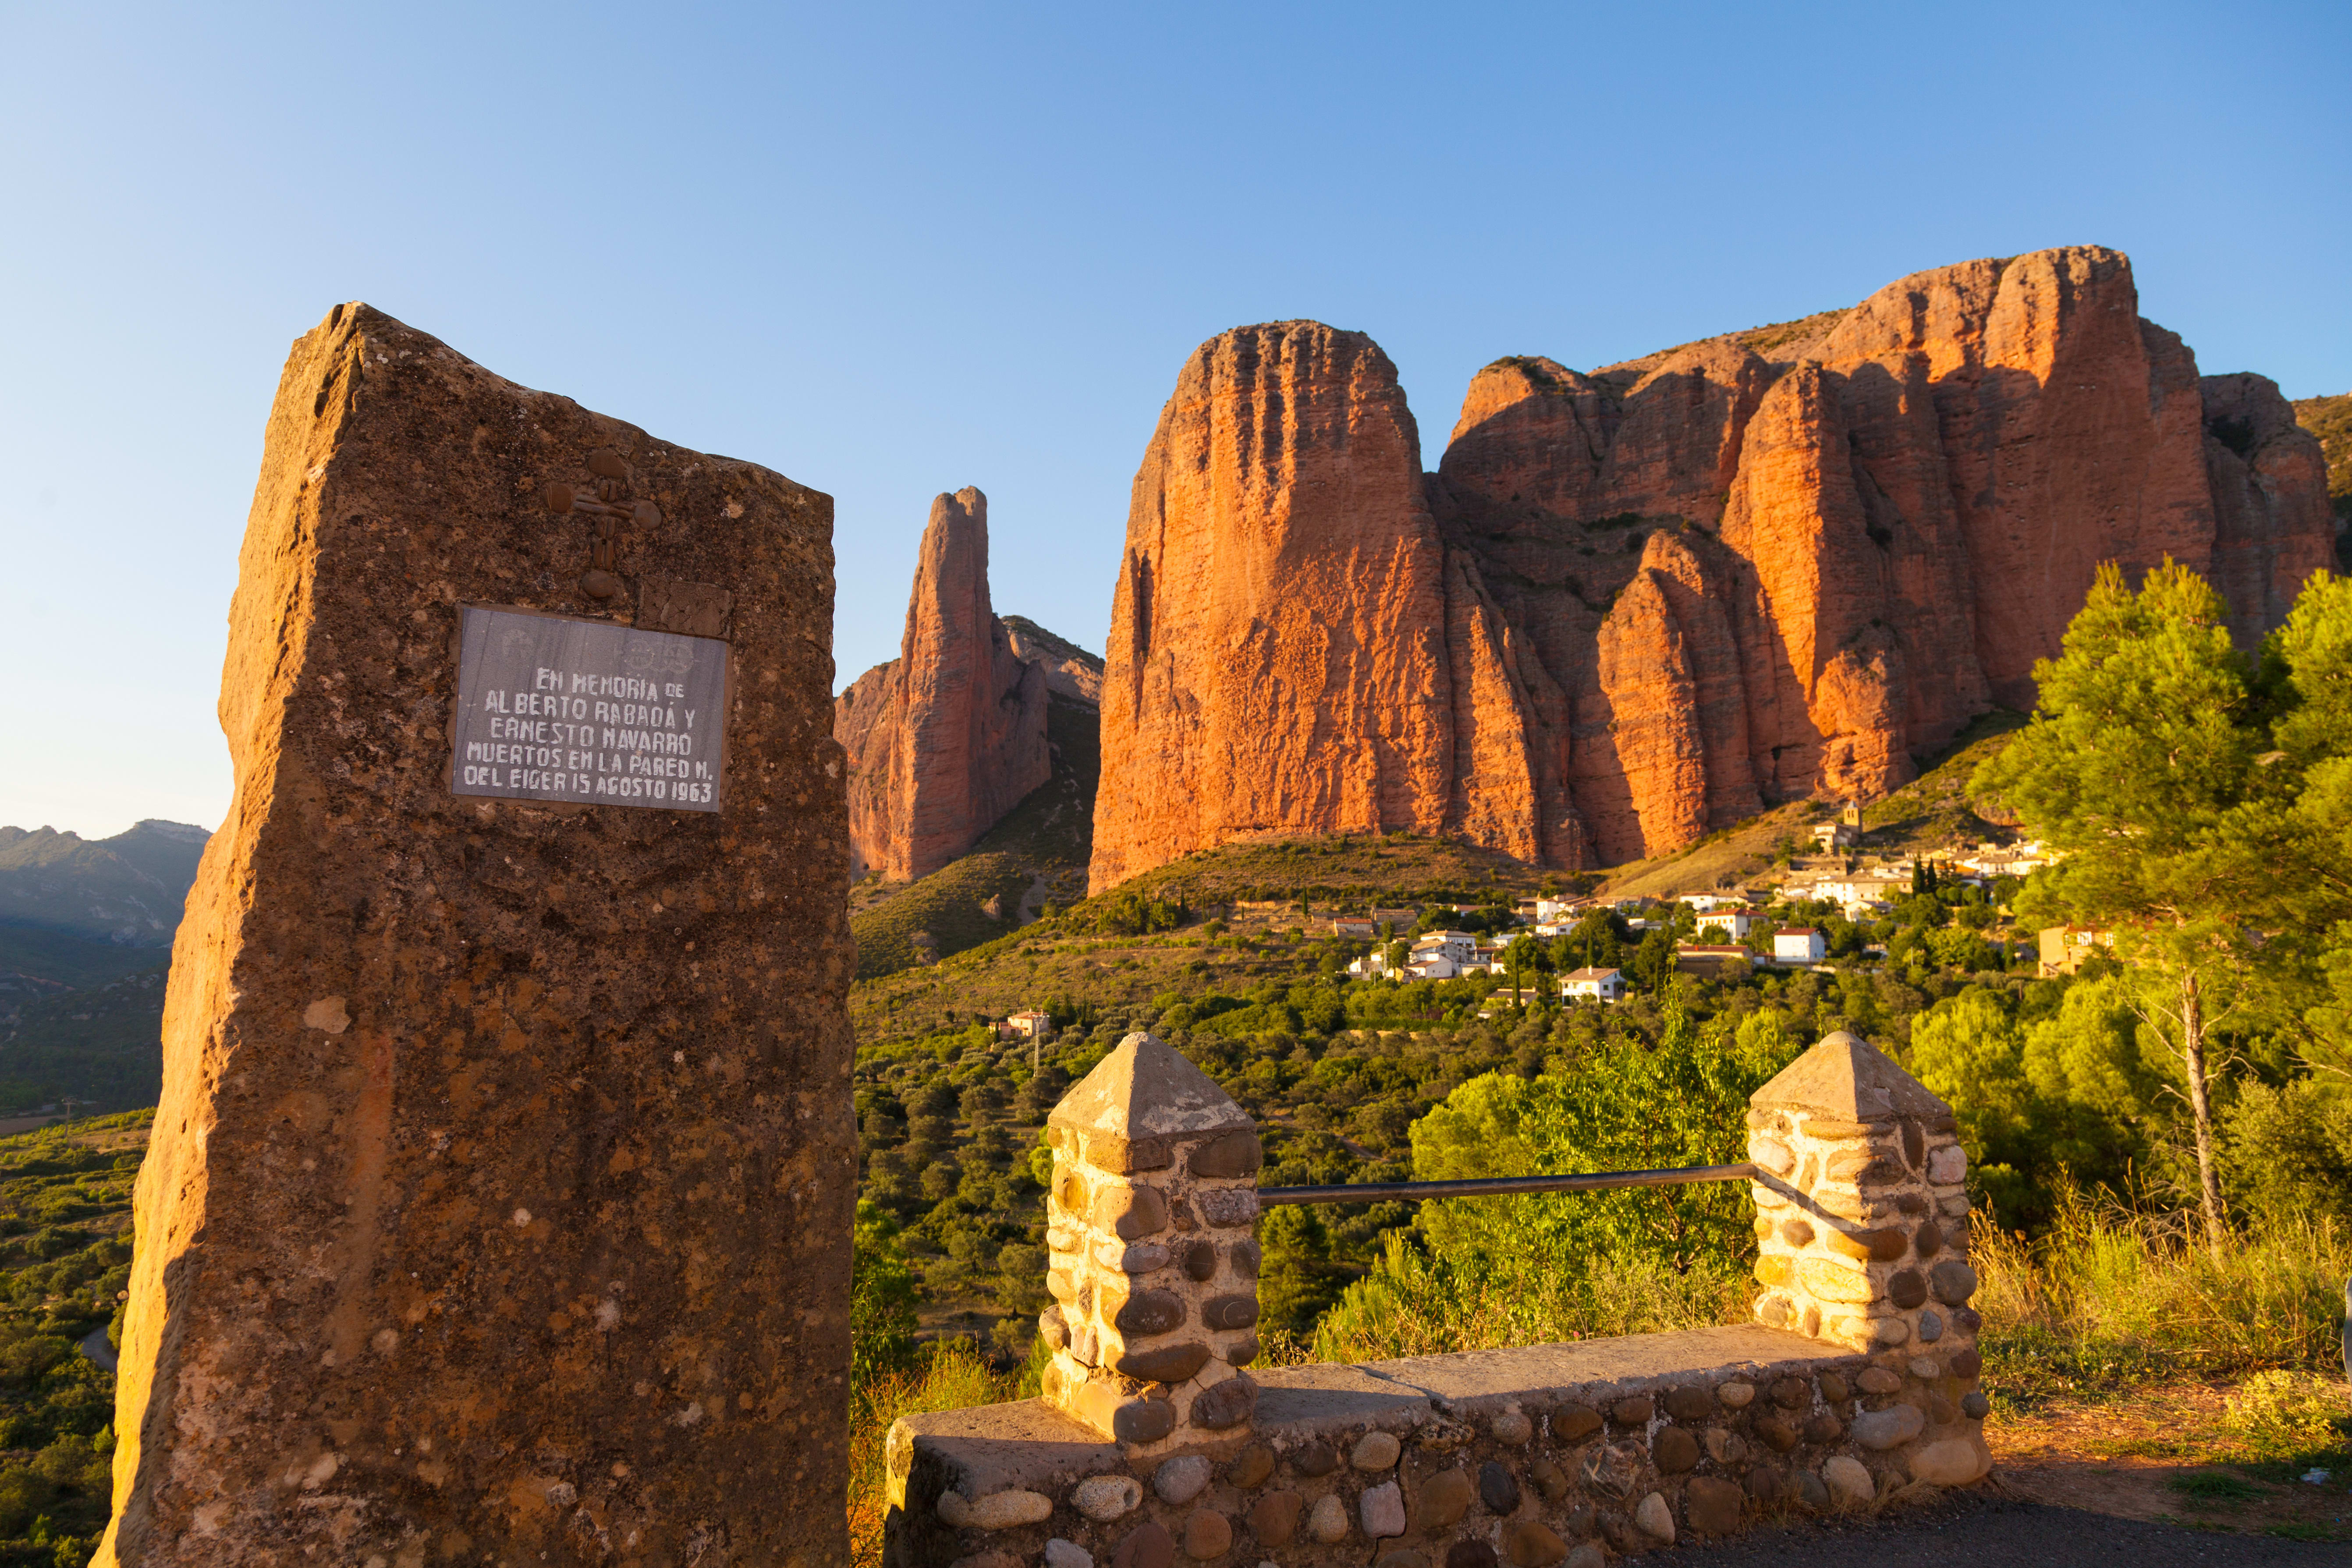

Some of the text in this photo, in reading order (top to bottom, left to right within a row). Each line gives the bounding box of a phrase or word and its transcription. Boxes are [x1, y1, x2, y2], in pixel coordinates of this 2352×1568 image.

[536, 667, 685, 701] EN MEMORIA DE
[485, 689, 587, 719] ALBERTO
[685, 709, 695, 729] Y
[491, 717, 692, 756] ERNESTO NAVARRO
[467, 741, 563, 767] MUERTOS
[568, 749, 592, 770] EN
[599, 753, 621, 773] LA
[629, 755, 689, 779] PARED
[464, 765, 712, 803] DEL EIGER 15 AGOSTO 1963
